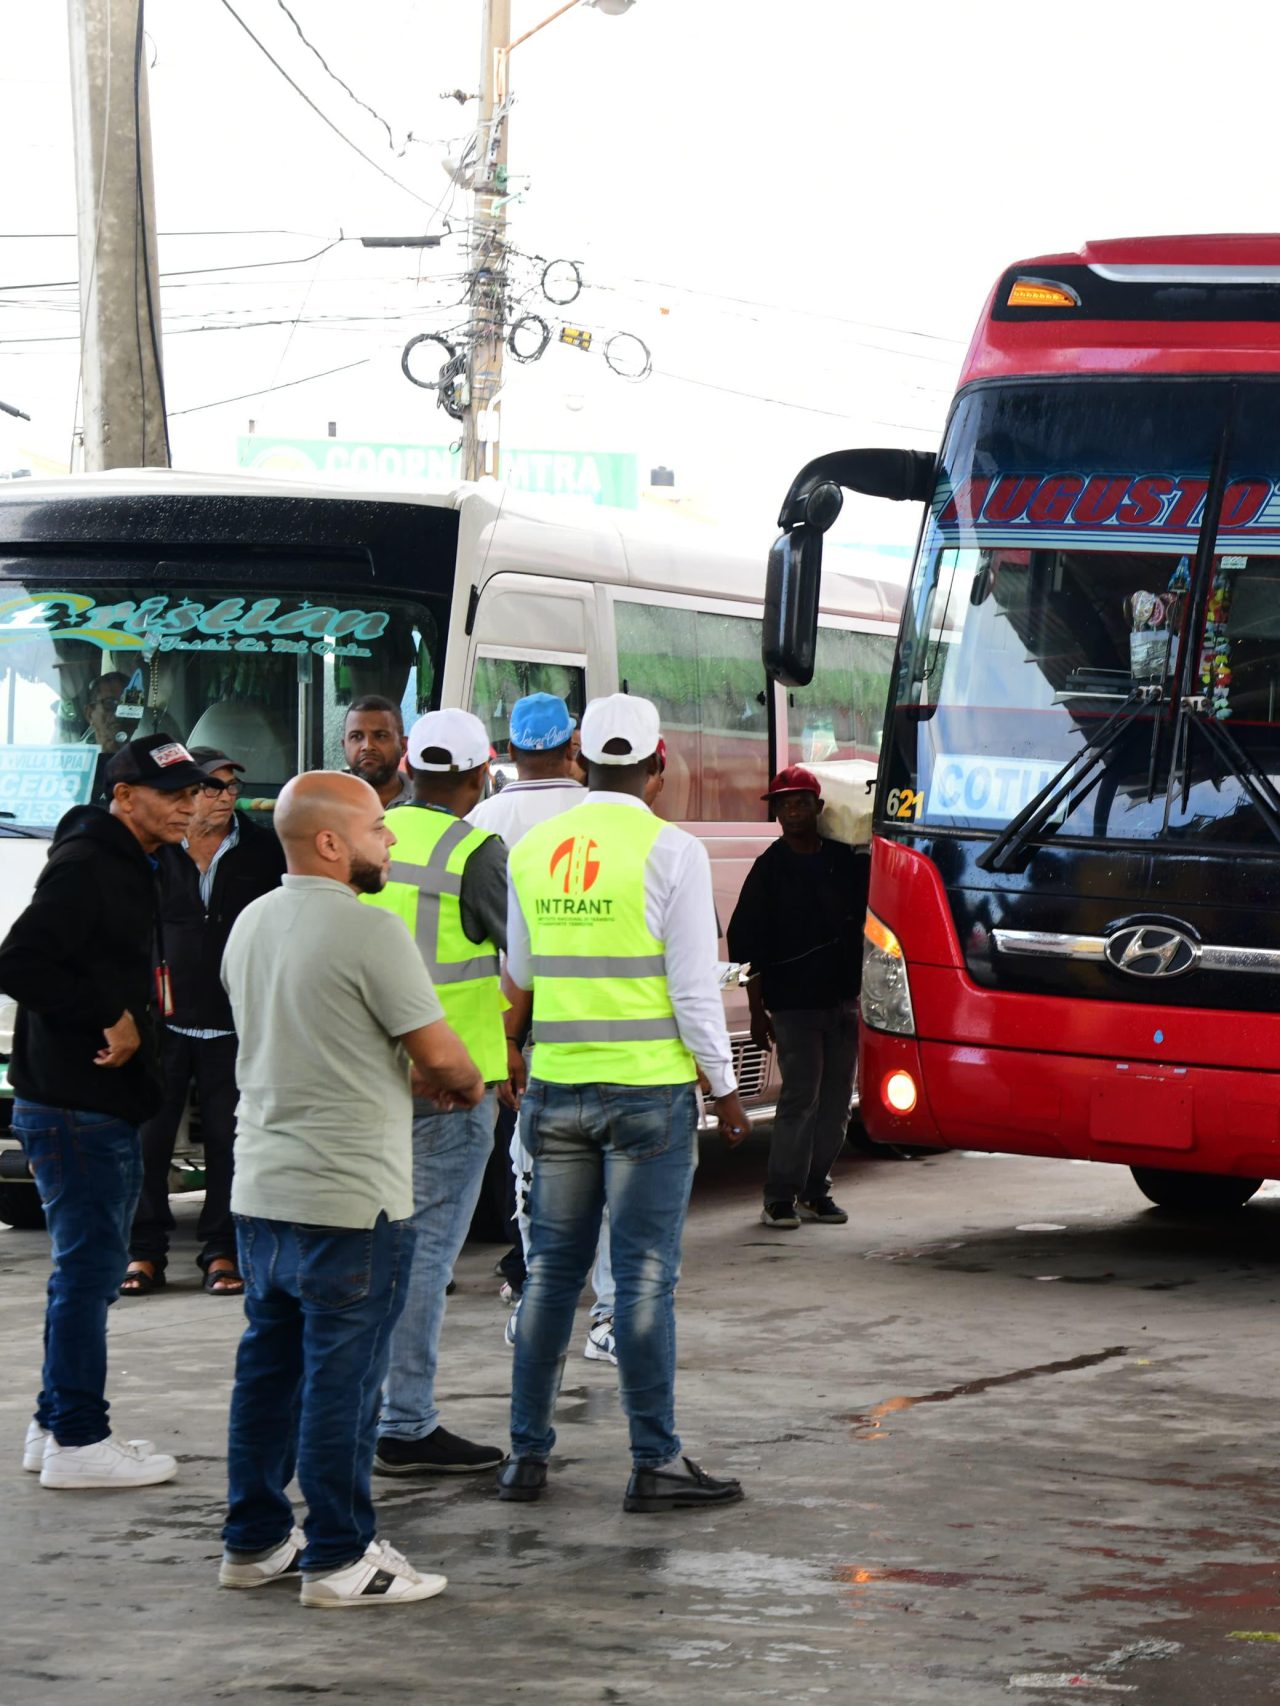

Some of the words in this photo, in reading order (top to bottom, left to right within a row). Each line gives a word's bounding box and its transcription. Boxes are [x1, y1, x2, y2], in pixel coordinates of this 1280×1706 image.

[936, 475, 1268, 528] AUGUSTO
[51, 755, 84, 769] TAPIA
[887, 788, 925, 819] 621
[535, 899, 613, 915] INTRANT
